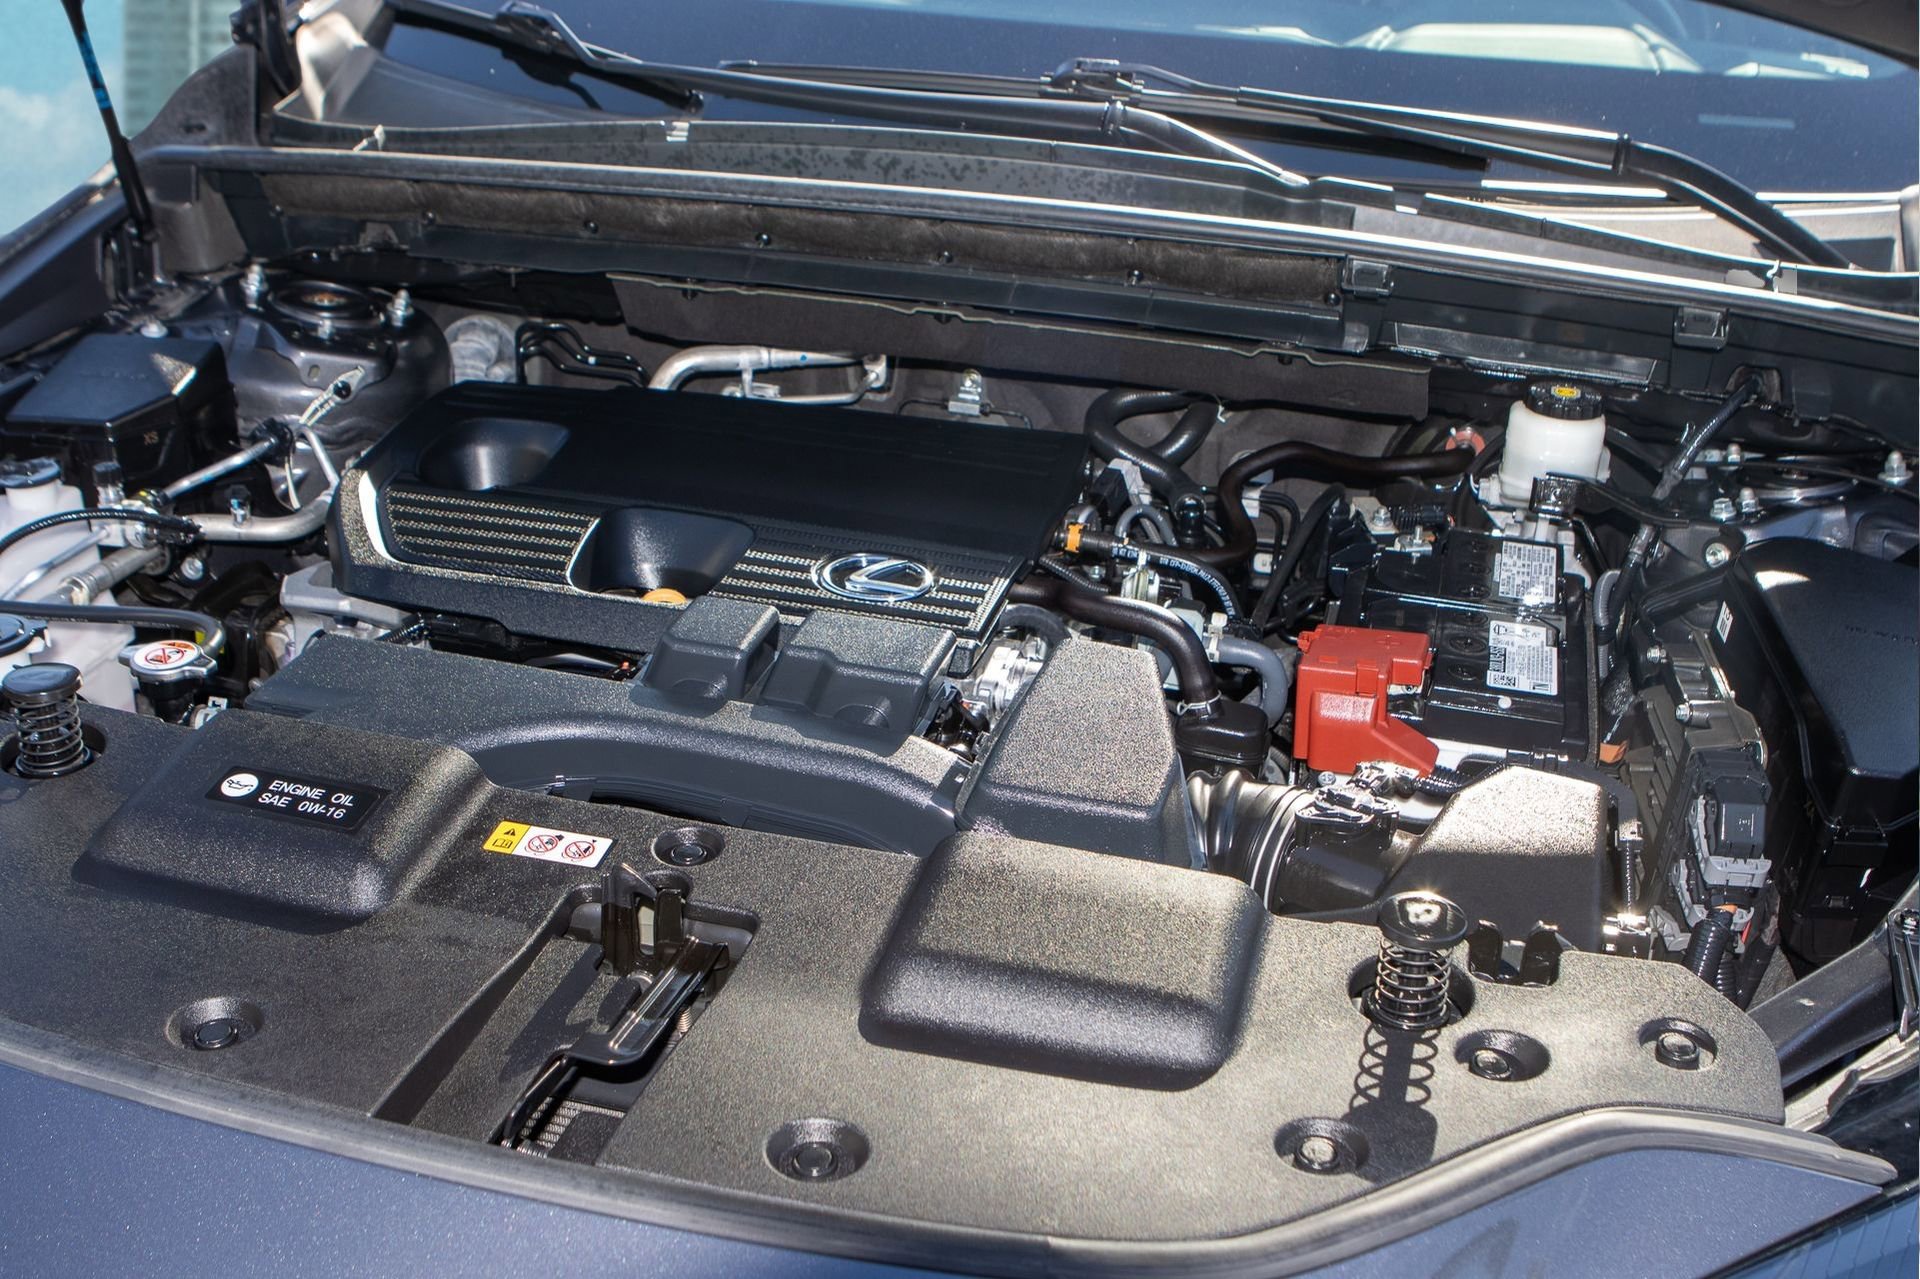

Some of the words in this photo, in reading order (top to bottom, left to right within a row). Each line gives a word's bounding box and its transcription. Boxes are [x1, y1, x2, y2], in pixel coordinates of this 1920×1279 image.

[257, 792, 293, 808] SAE
[297, 800, 347, 819] 0W-16
[268, 779, 326, 800] ENGINE
[331, 793, 354, 807] OIL
